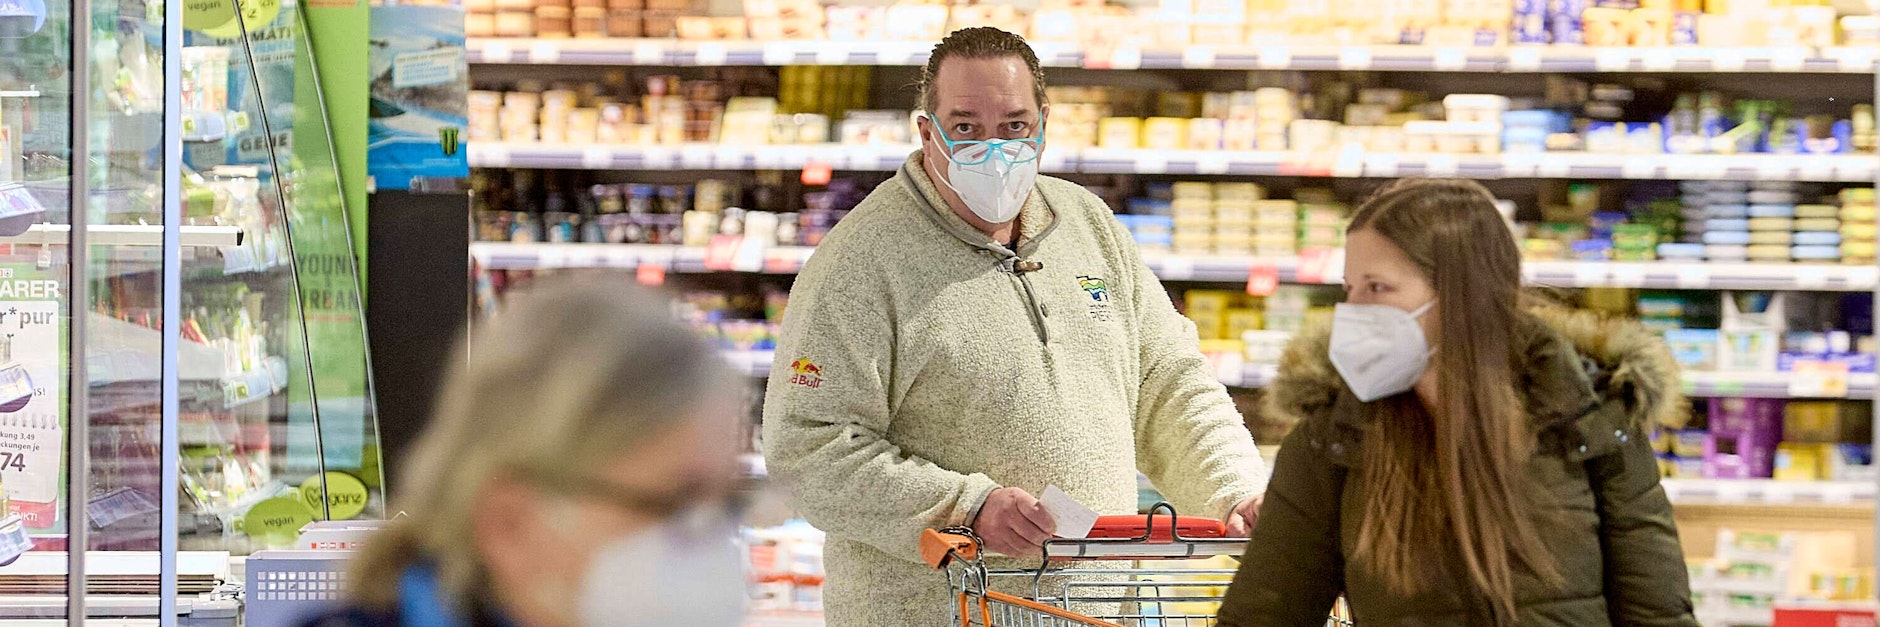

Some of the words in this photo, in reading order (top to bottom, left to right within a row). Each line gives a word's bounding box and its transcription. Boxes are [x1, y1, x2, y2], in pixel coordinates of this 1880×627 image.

[187, 0, 221, 11] vegan
[798, 375, 820, 388] Bull
[0, 451, 26, 472] 74
[263, 517, 294, 527] vegan
